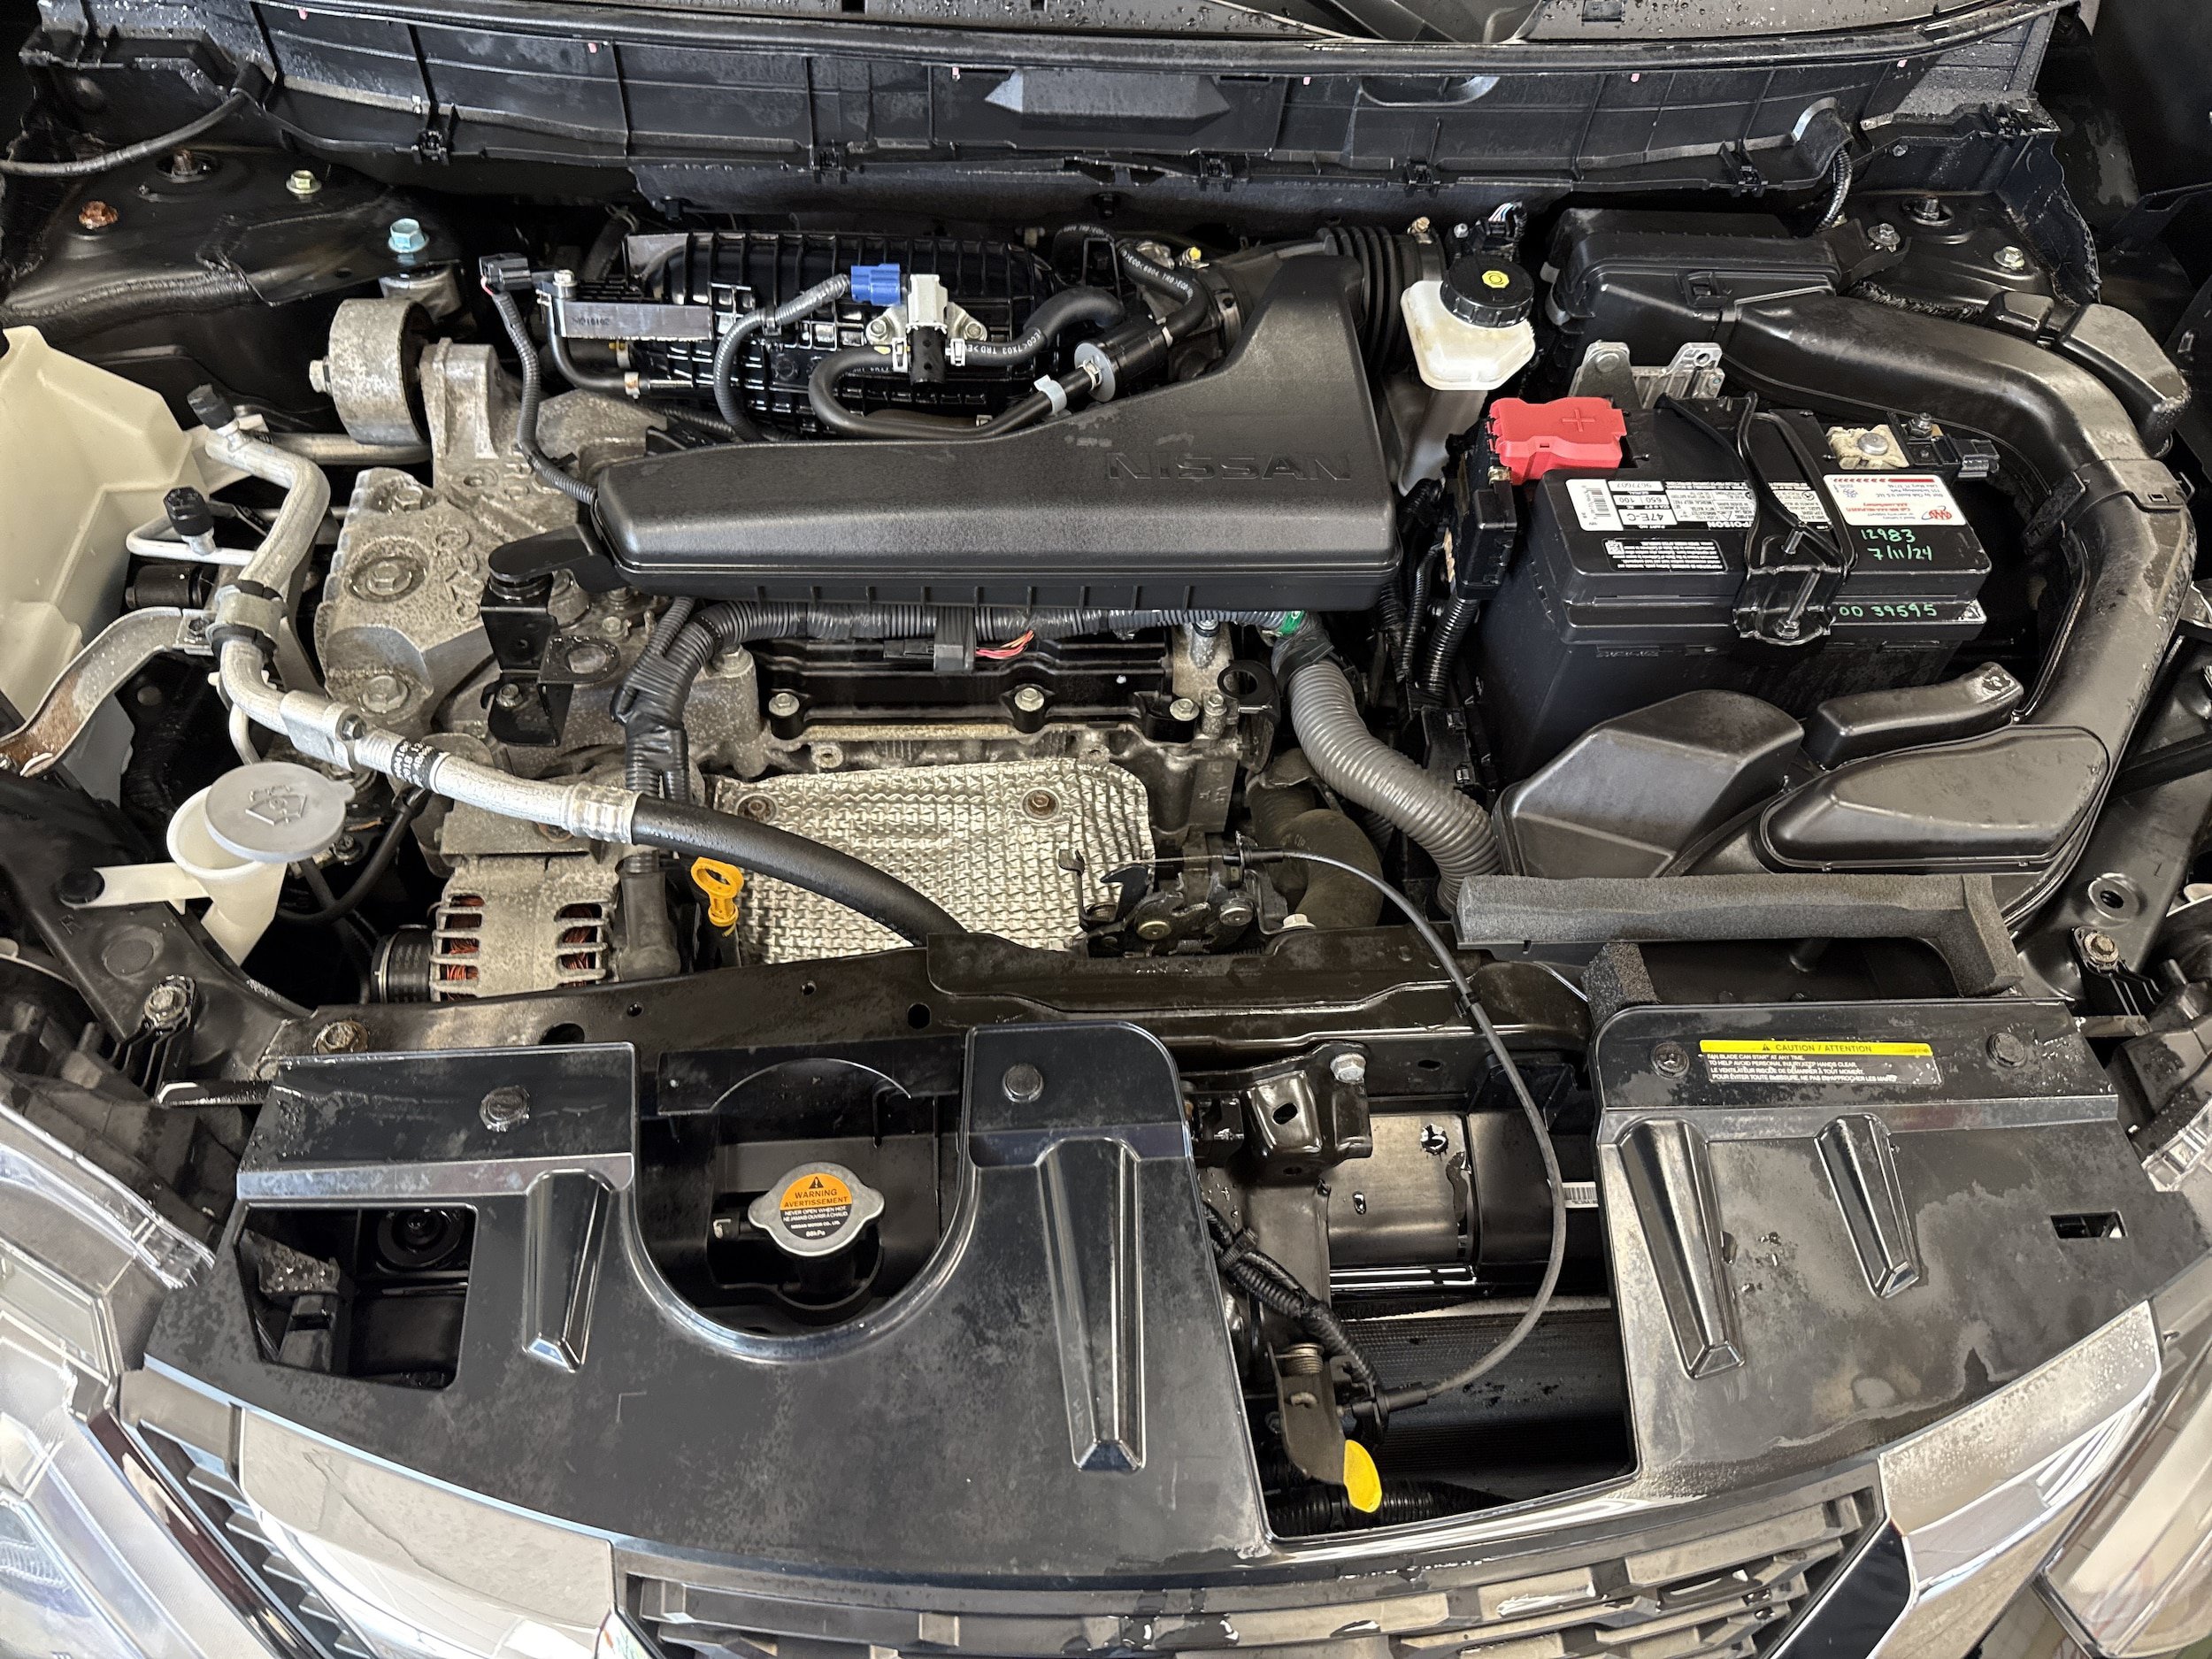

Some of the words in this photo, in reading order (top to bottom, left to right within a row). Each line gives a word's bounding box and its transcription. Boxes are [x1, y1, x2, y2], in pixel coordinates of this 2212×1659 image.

[1108, 451, 1351, 480] NISSAN
[1861, 528, 1916, 543] 12983
[1867, 544, 1932, 561] 7/11/24
[1870, 603, 1938, 618] 39595
[403, 755, 413, 784] 2018
[1825, 1045, 1872, 1053] ATTENTION
[784, 1196, 848, 1207] AVERTISSEMENT
[795, 1189, 837, 1199] WARNING
